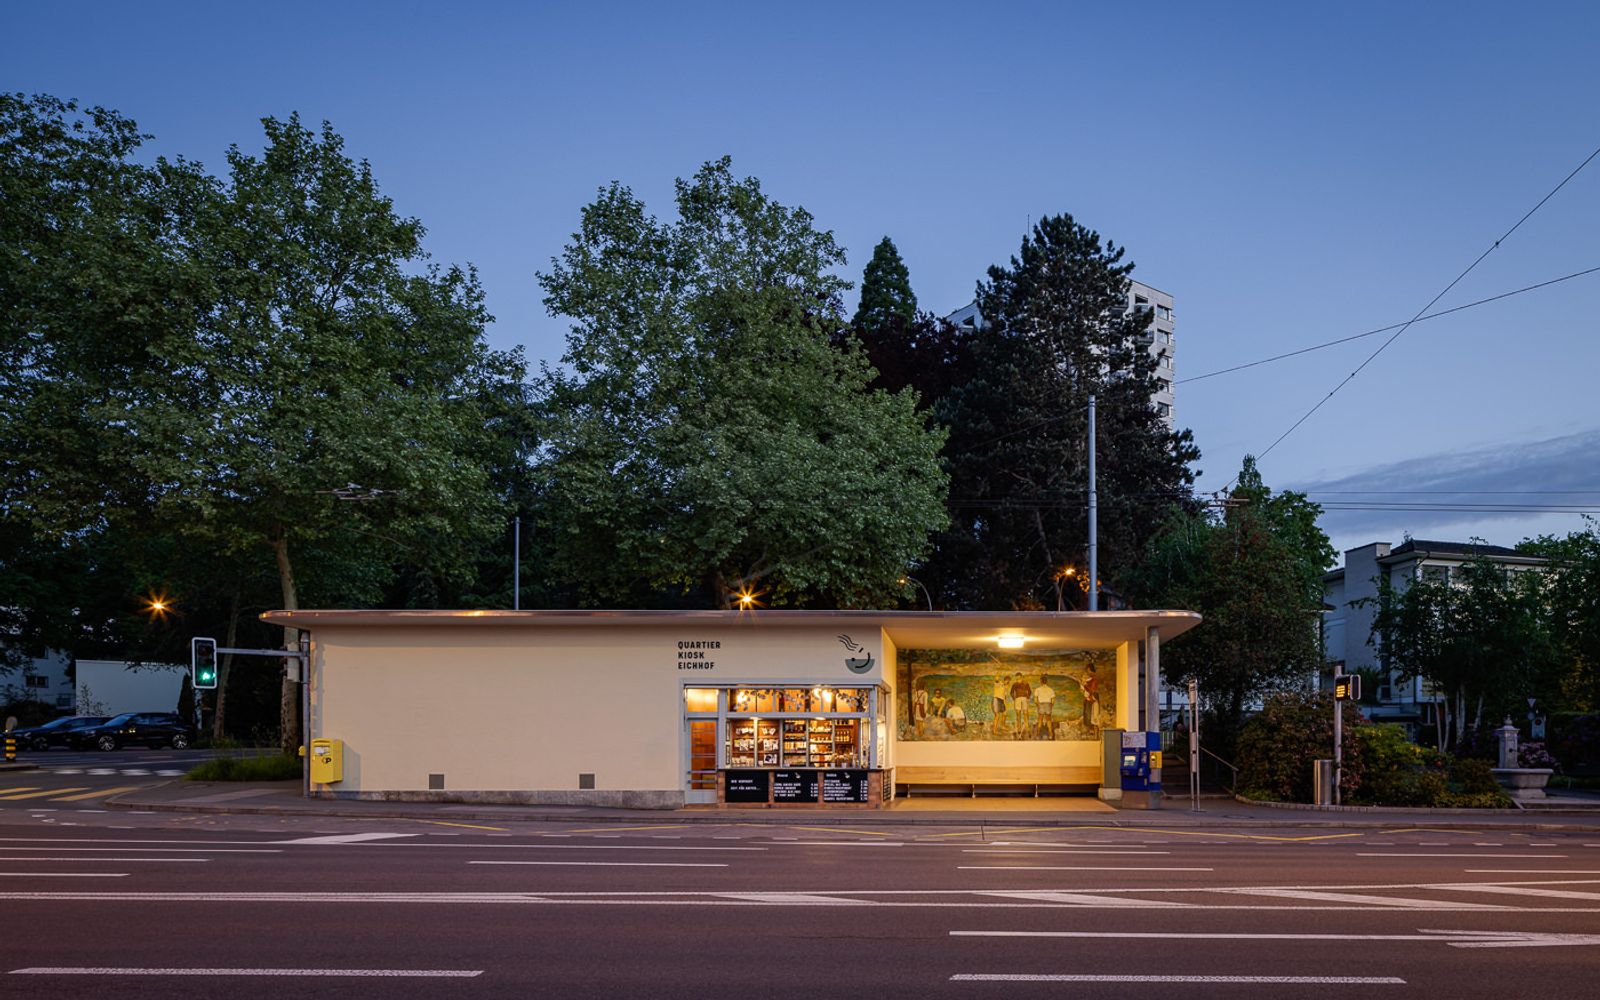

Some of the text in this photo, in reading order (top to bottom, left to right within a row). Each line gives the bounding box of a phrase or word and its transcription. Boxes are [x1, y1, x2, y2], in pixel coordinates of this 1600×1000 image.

[678, 641, 721, 650] QUARTIER
[678, 652, 705, 660] KIOSK
[678, 662, 715, 670] EICHHOF
